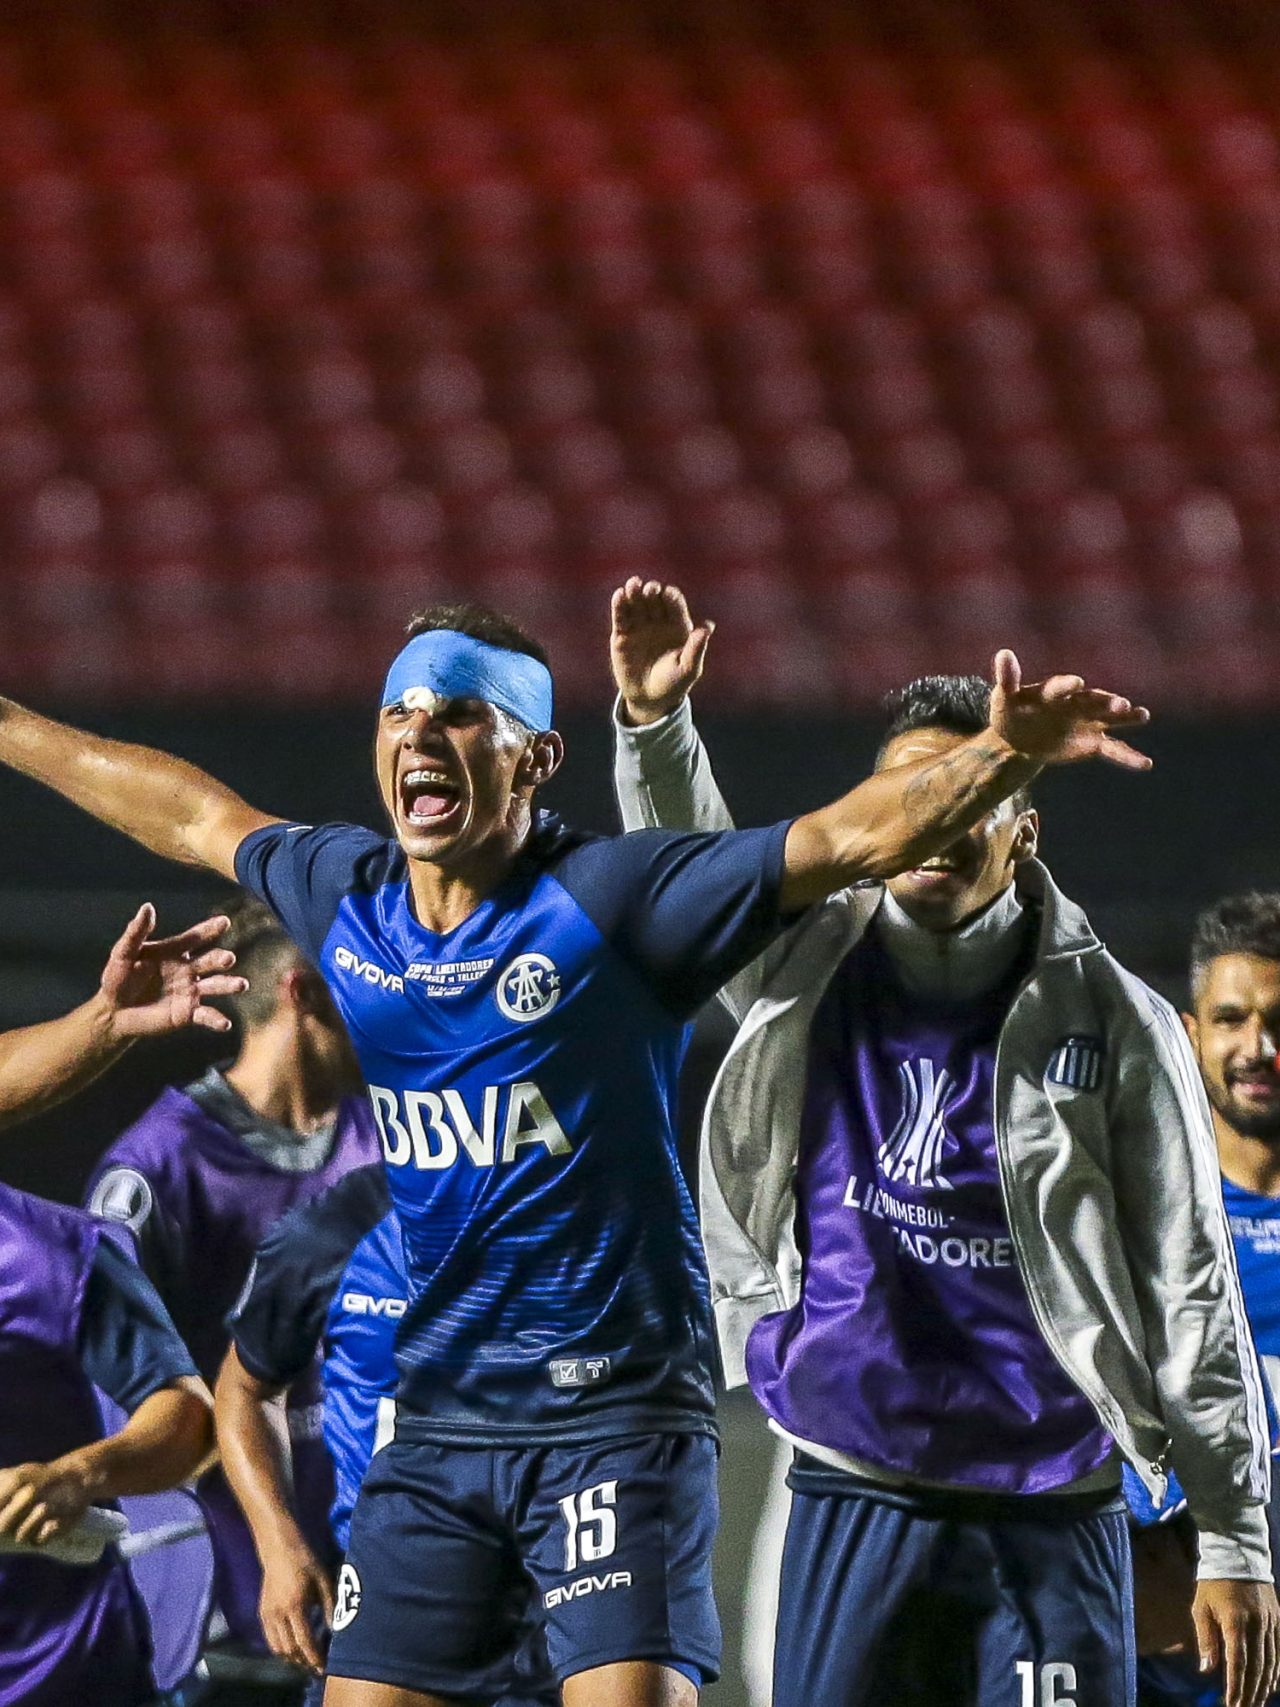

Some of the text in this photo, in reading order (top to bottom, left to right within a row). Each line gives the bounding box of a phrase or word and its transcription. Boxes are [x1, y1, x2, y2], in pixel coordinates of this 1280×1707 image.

[368, 1081, 573, 1171] BBVA
[342, 1293, 408, 1318] GIVO
[558, 1480, 618, 1573] 15
[543, 1570, 632, 1610] GIVOVA
